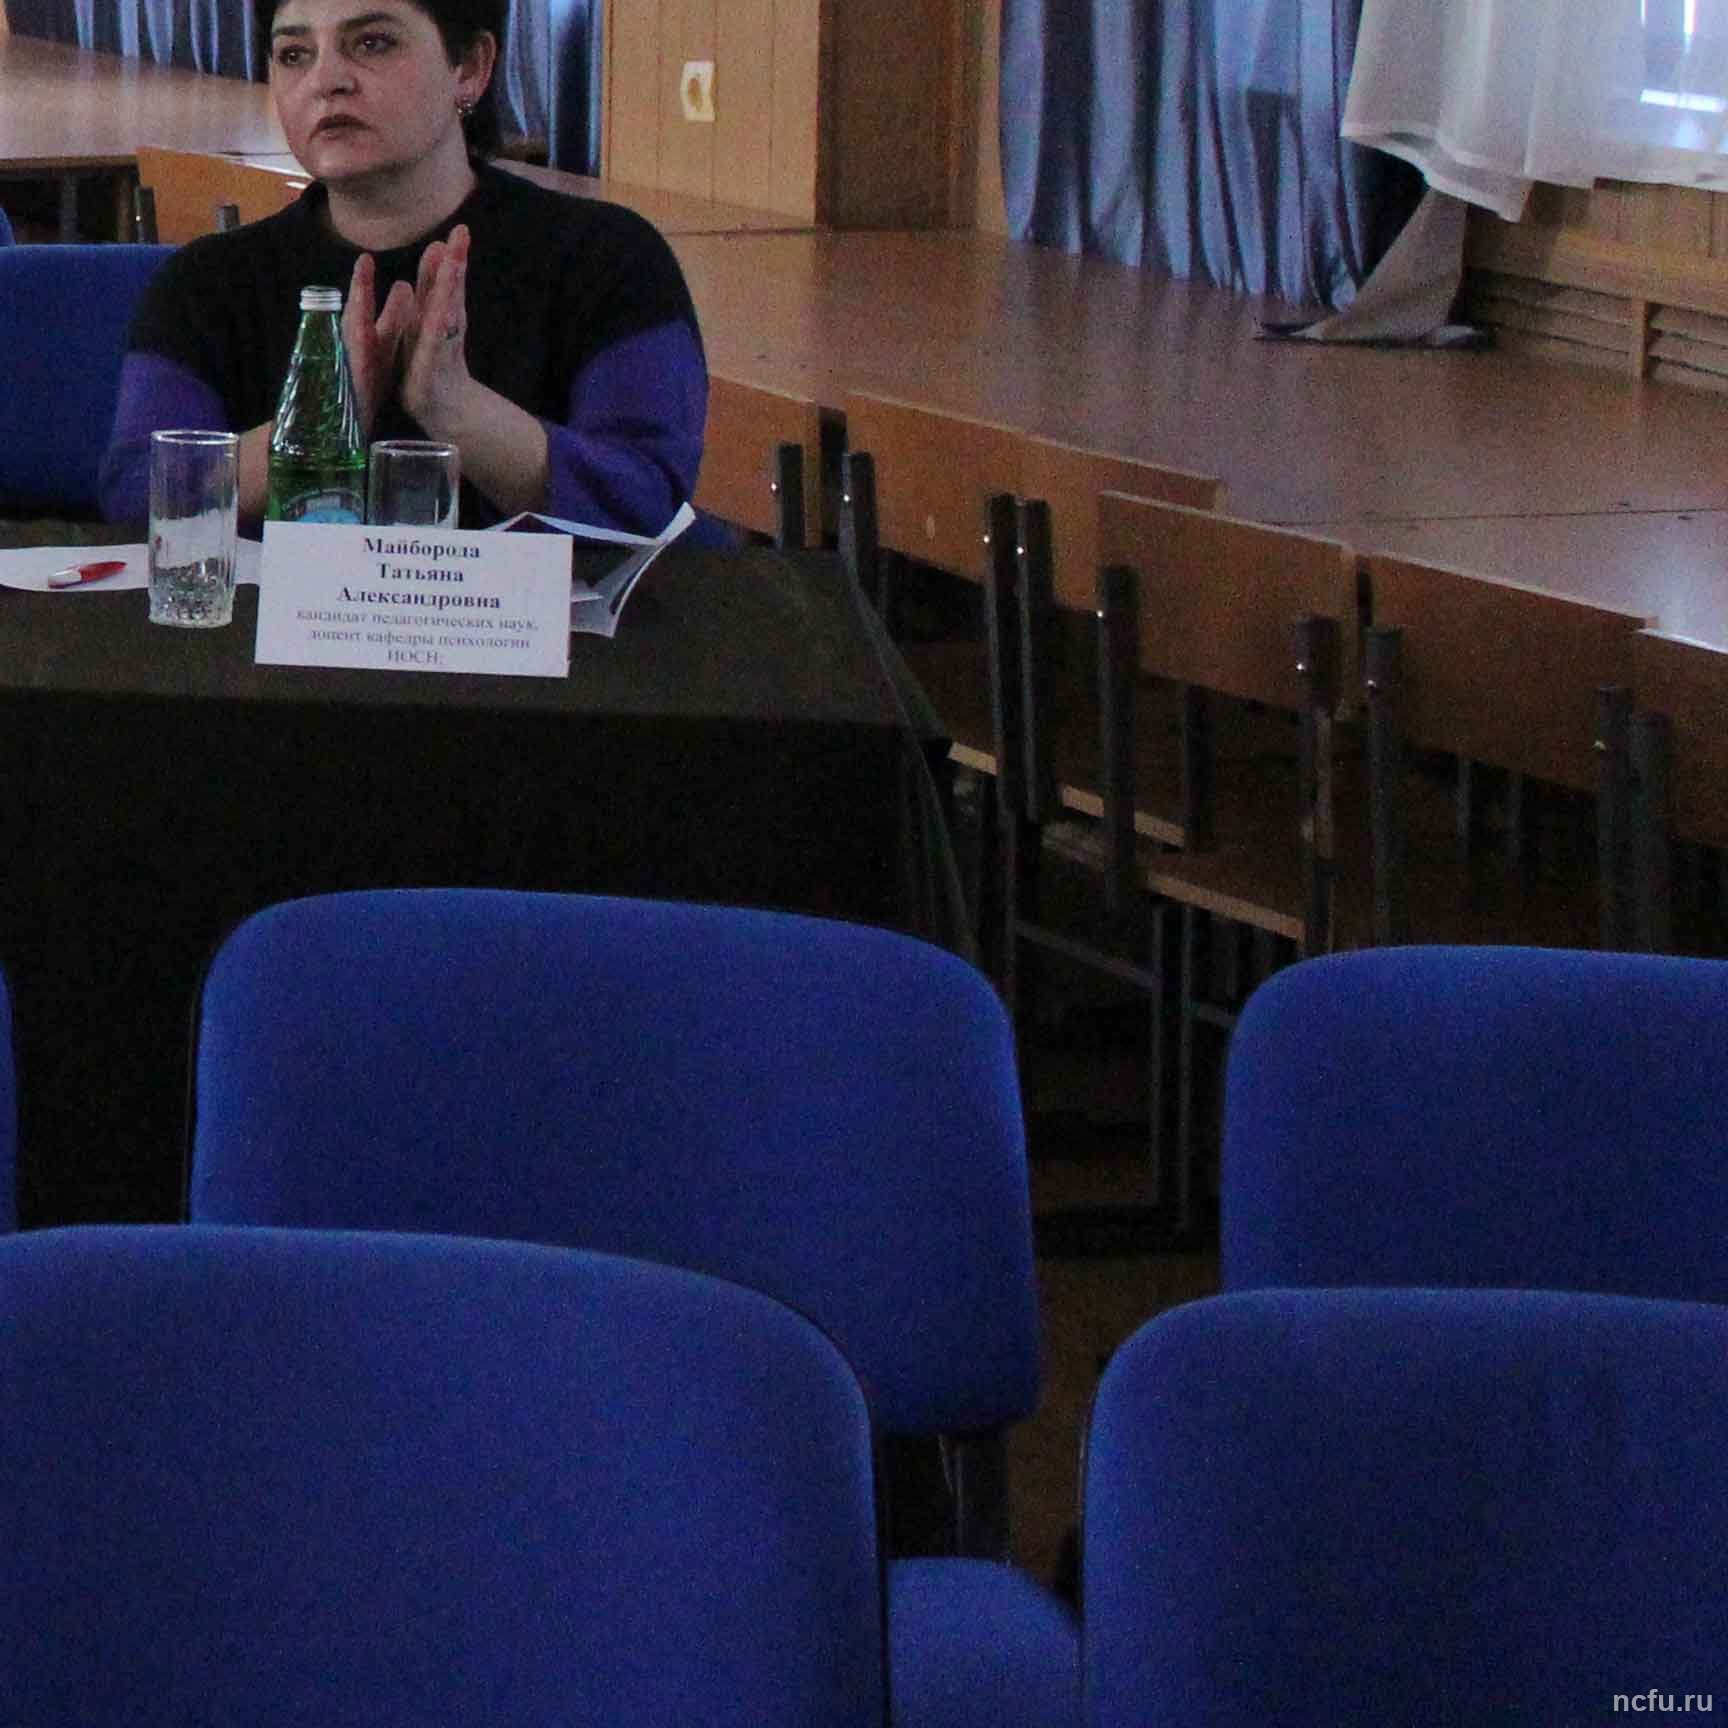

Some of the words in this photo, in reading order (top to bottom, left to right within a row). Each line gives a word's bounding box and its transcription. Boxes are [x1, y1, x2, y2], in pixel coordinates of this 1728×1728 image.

[363, 537, 480, 561] Майборода
[378, 562, 464, 583] Татьяна
[337, 587, 500, 610] Александровна
[297, 610, 366, 623] кандидат
[372, 612, 494, 630] педагогических
[309, 630, 361, 643] доцент
[367, 631, 434, 647] кафедры
[439, 635, 530, 650] психологии
